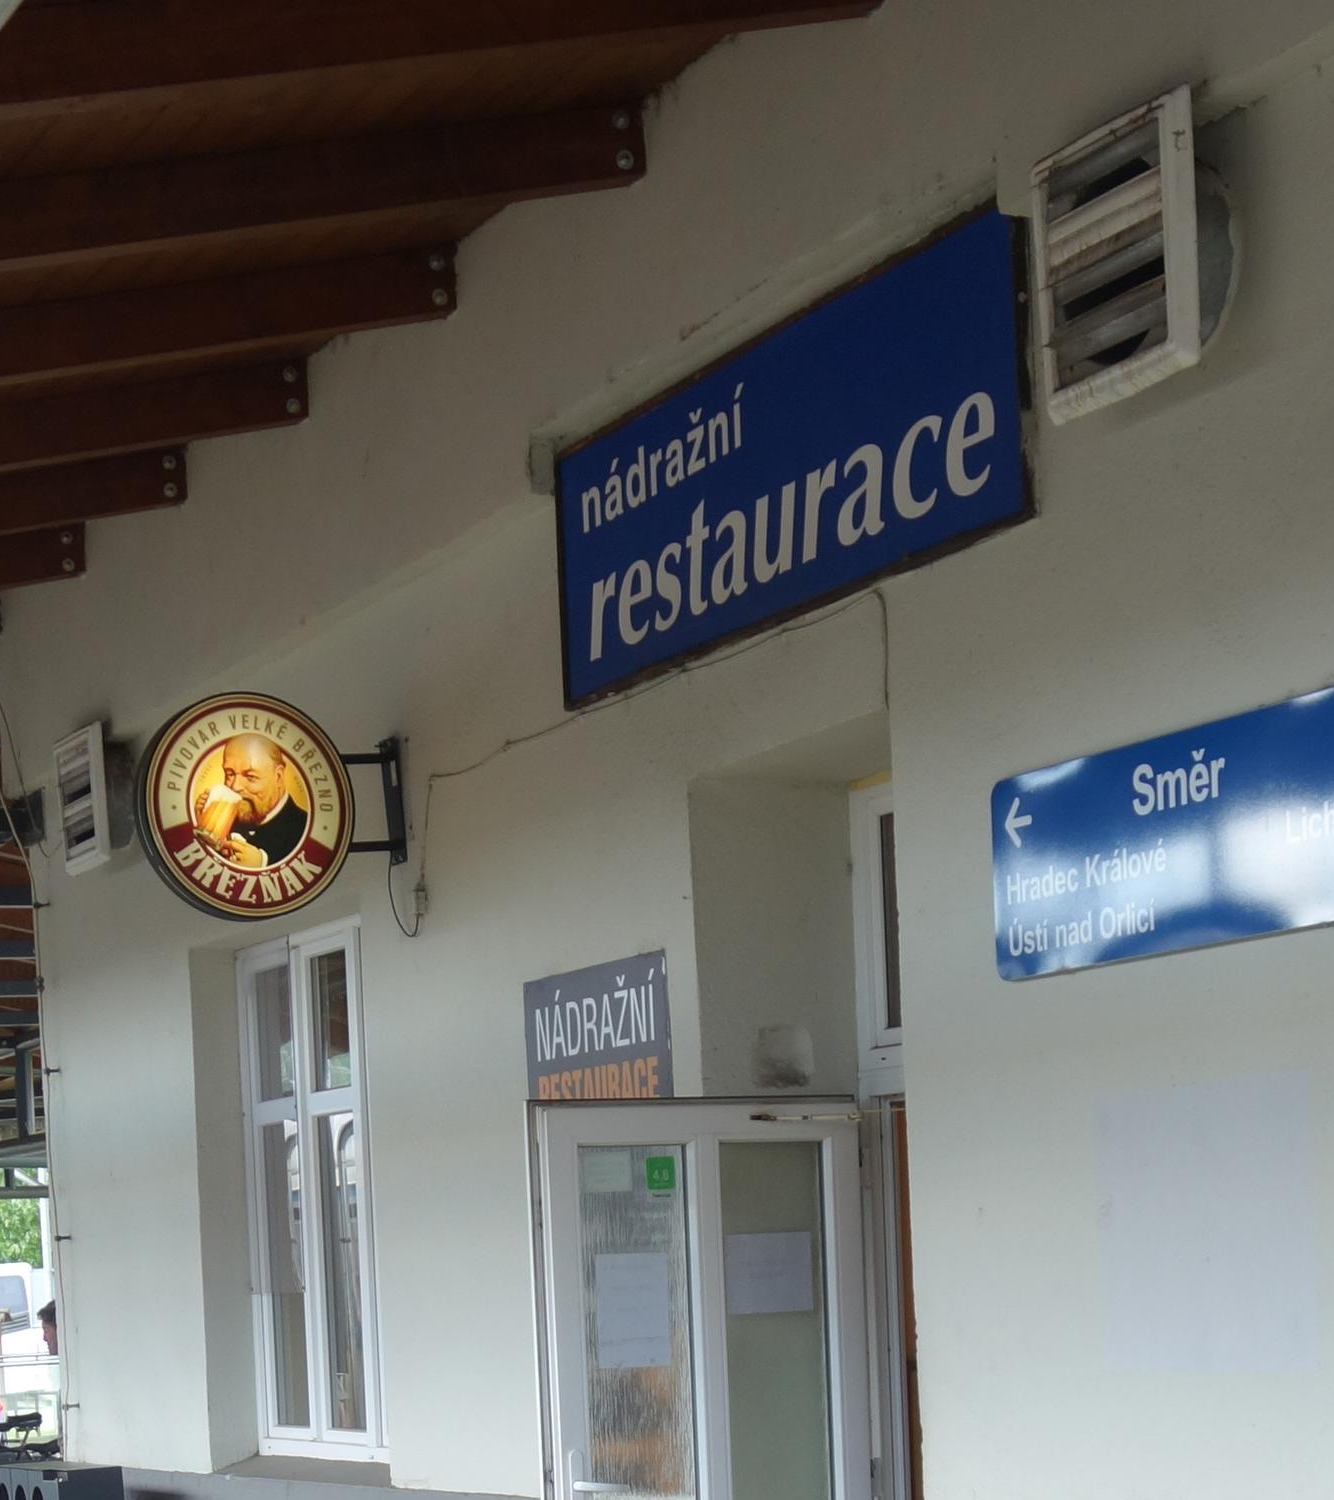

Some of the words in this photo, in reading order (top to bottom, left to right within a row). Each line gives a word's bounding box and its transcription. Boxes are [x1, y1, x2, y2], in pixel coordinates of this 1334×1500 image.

[581, 382, 744, 534] nádražní
[589, 391, 995, 662] restaurace
[167, 720, 221, 792] PIVOVAR
[228, 713, 287, 741] VELKÉ
[292, 738, 334, 813] BŘEZNO
[1132, 748, 1225, 816] Směr
[174, 840, 323, 904] BŘEZŇÁK
[1006, 865, 1079, 906] Hradec
[1085, 838, 1167, 888] Králové
[1009, 918, 1049, 957] Ústí
[1055, 911, 1092, 948] nad
[1099, 898, 1155, 940] Orlicí
[535, 968, 655, 1062] NÁDRAŽNÍ
